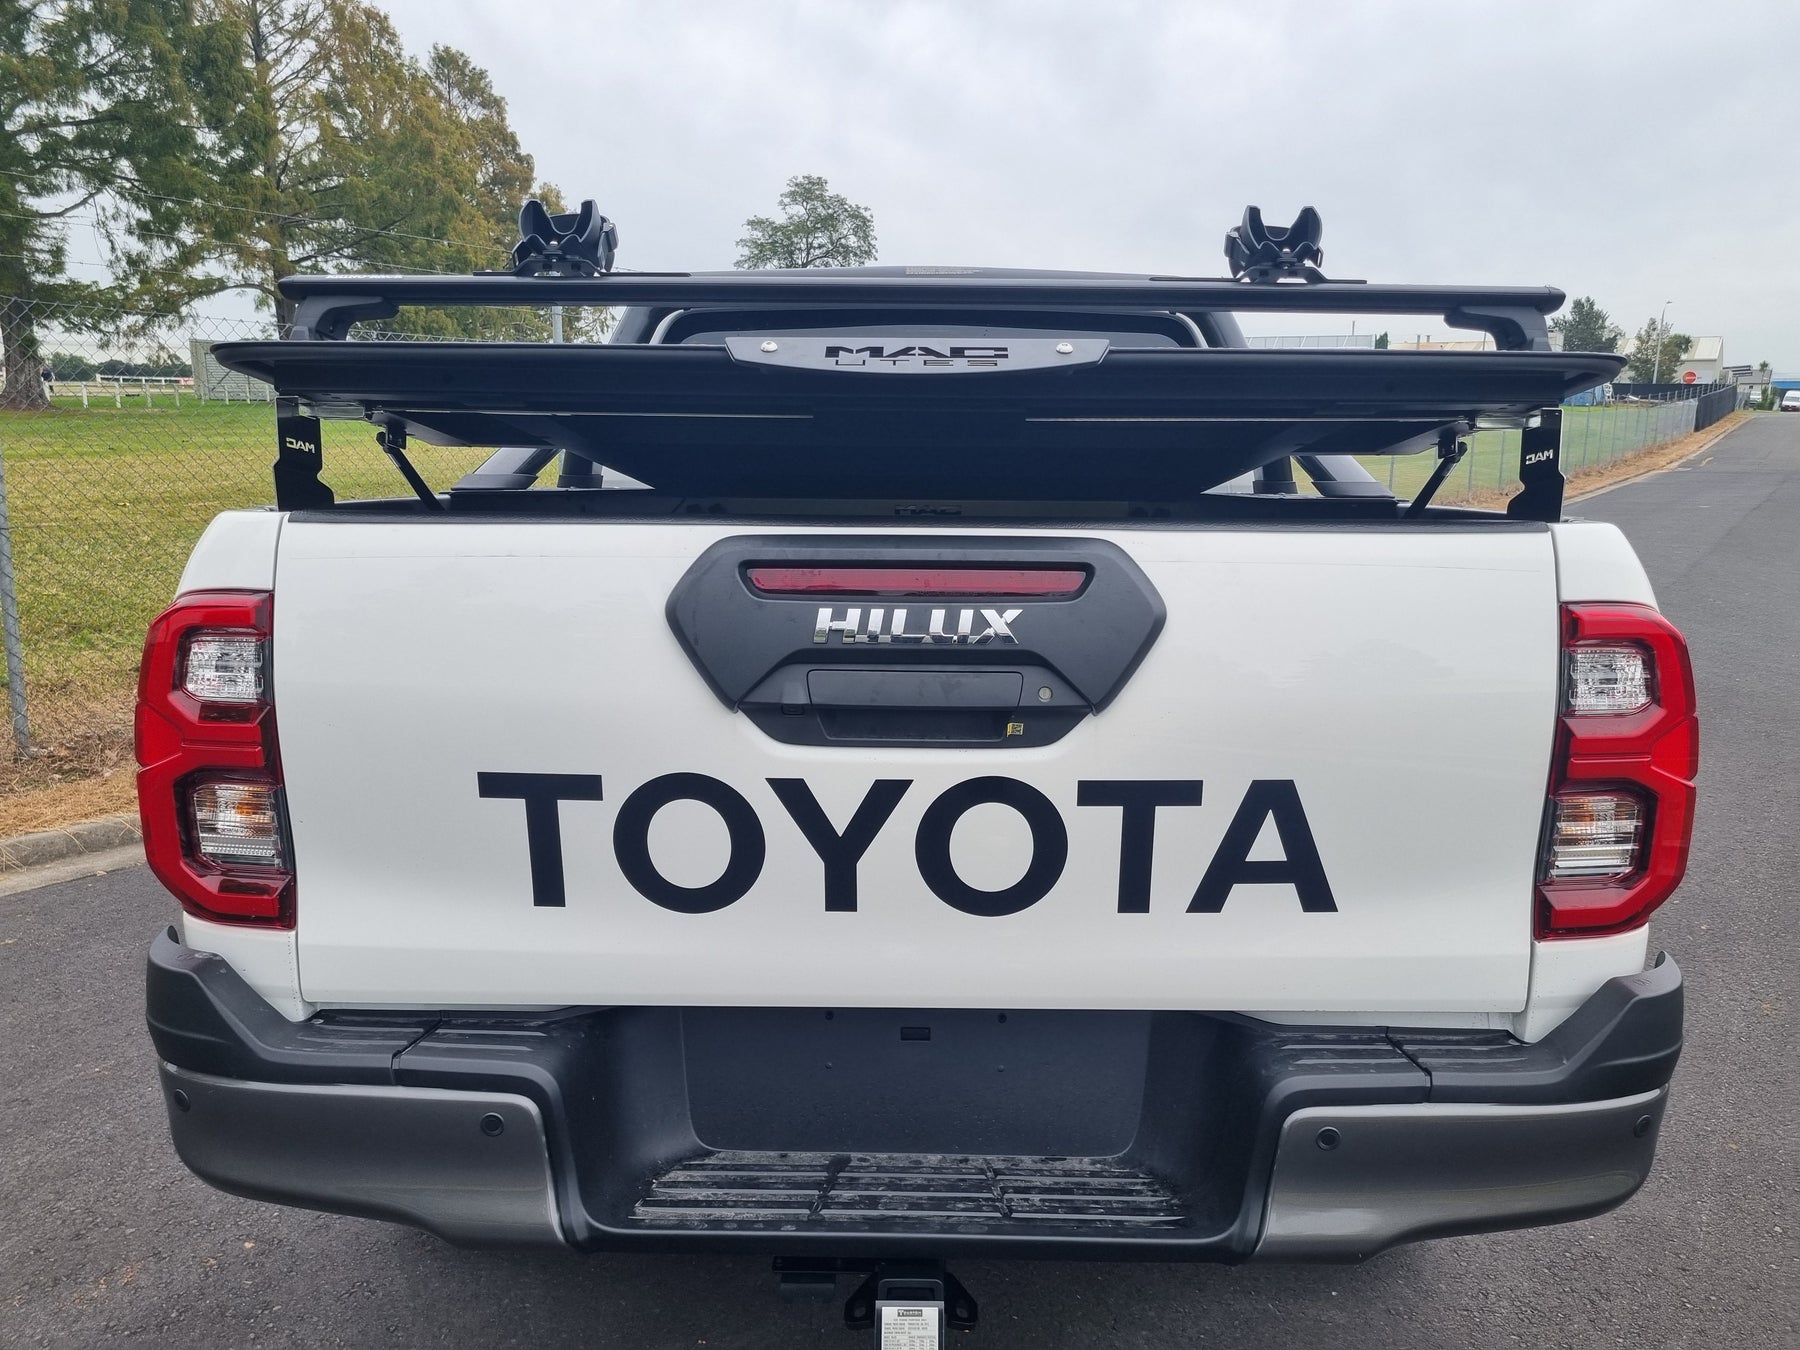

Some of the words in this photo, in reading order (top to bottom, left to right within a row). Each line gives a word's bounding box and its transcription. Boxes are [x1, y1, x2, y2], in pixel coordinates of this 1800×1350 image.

[825, 346, 1008, 359] MAC
[835, 359, 998, 367] UTES
[813, 607, 1023, 645] HILUX
[477, 772, 1338, 917] TOYOTA
